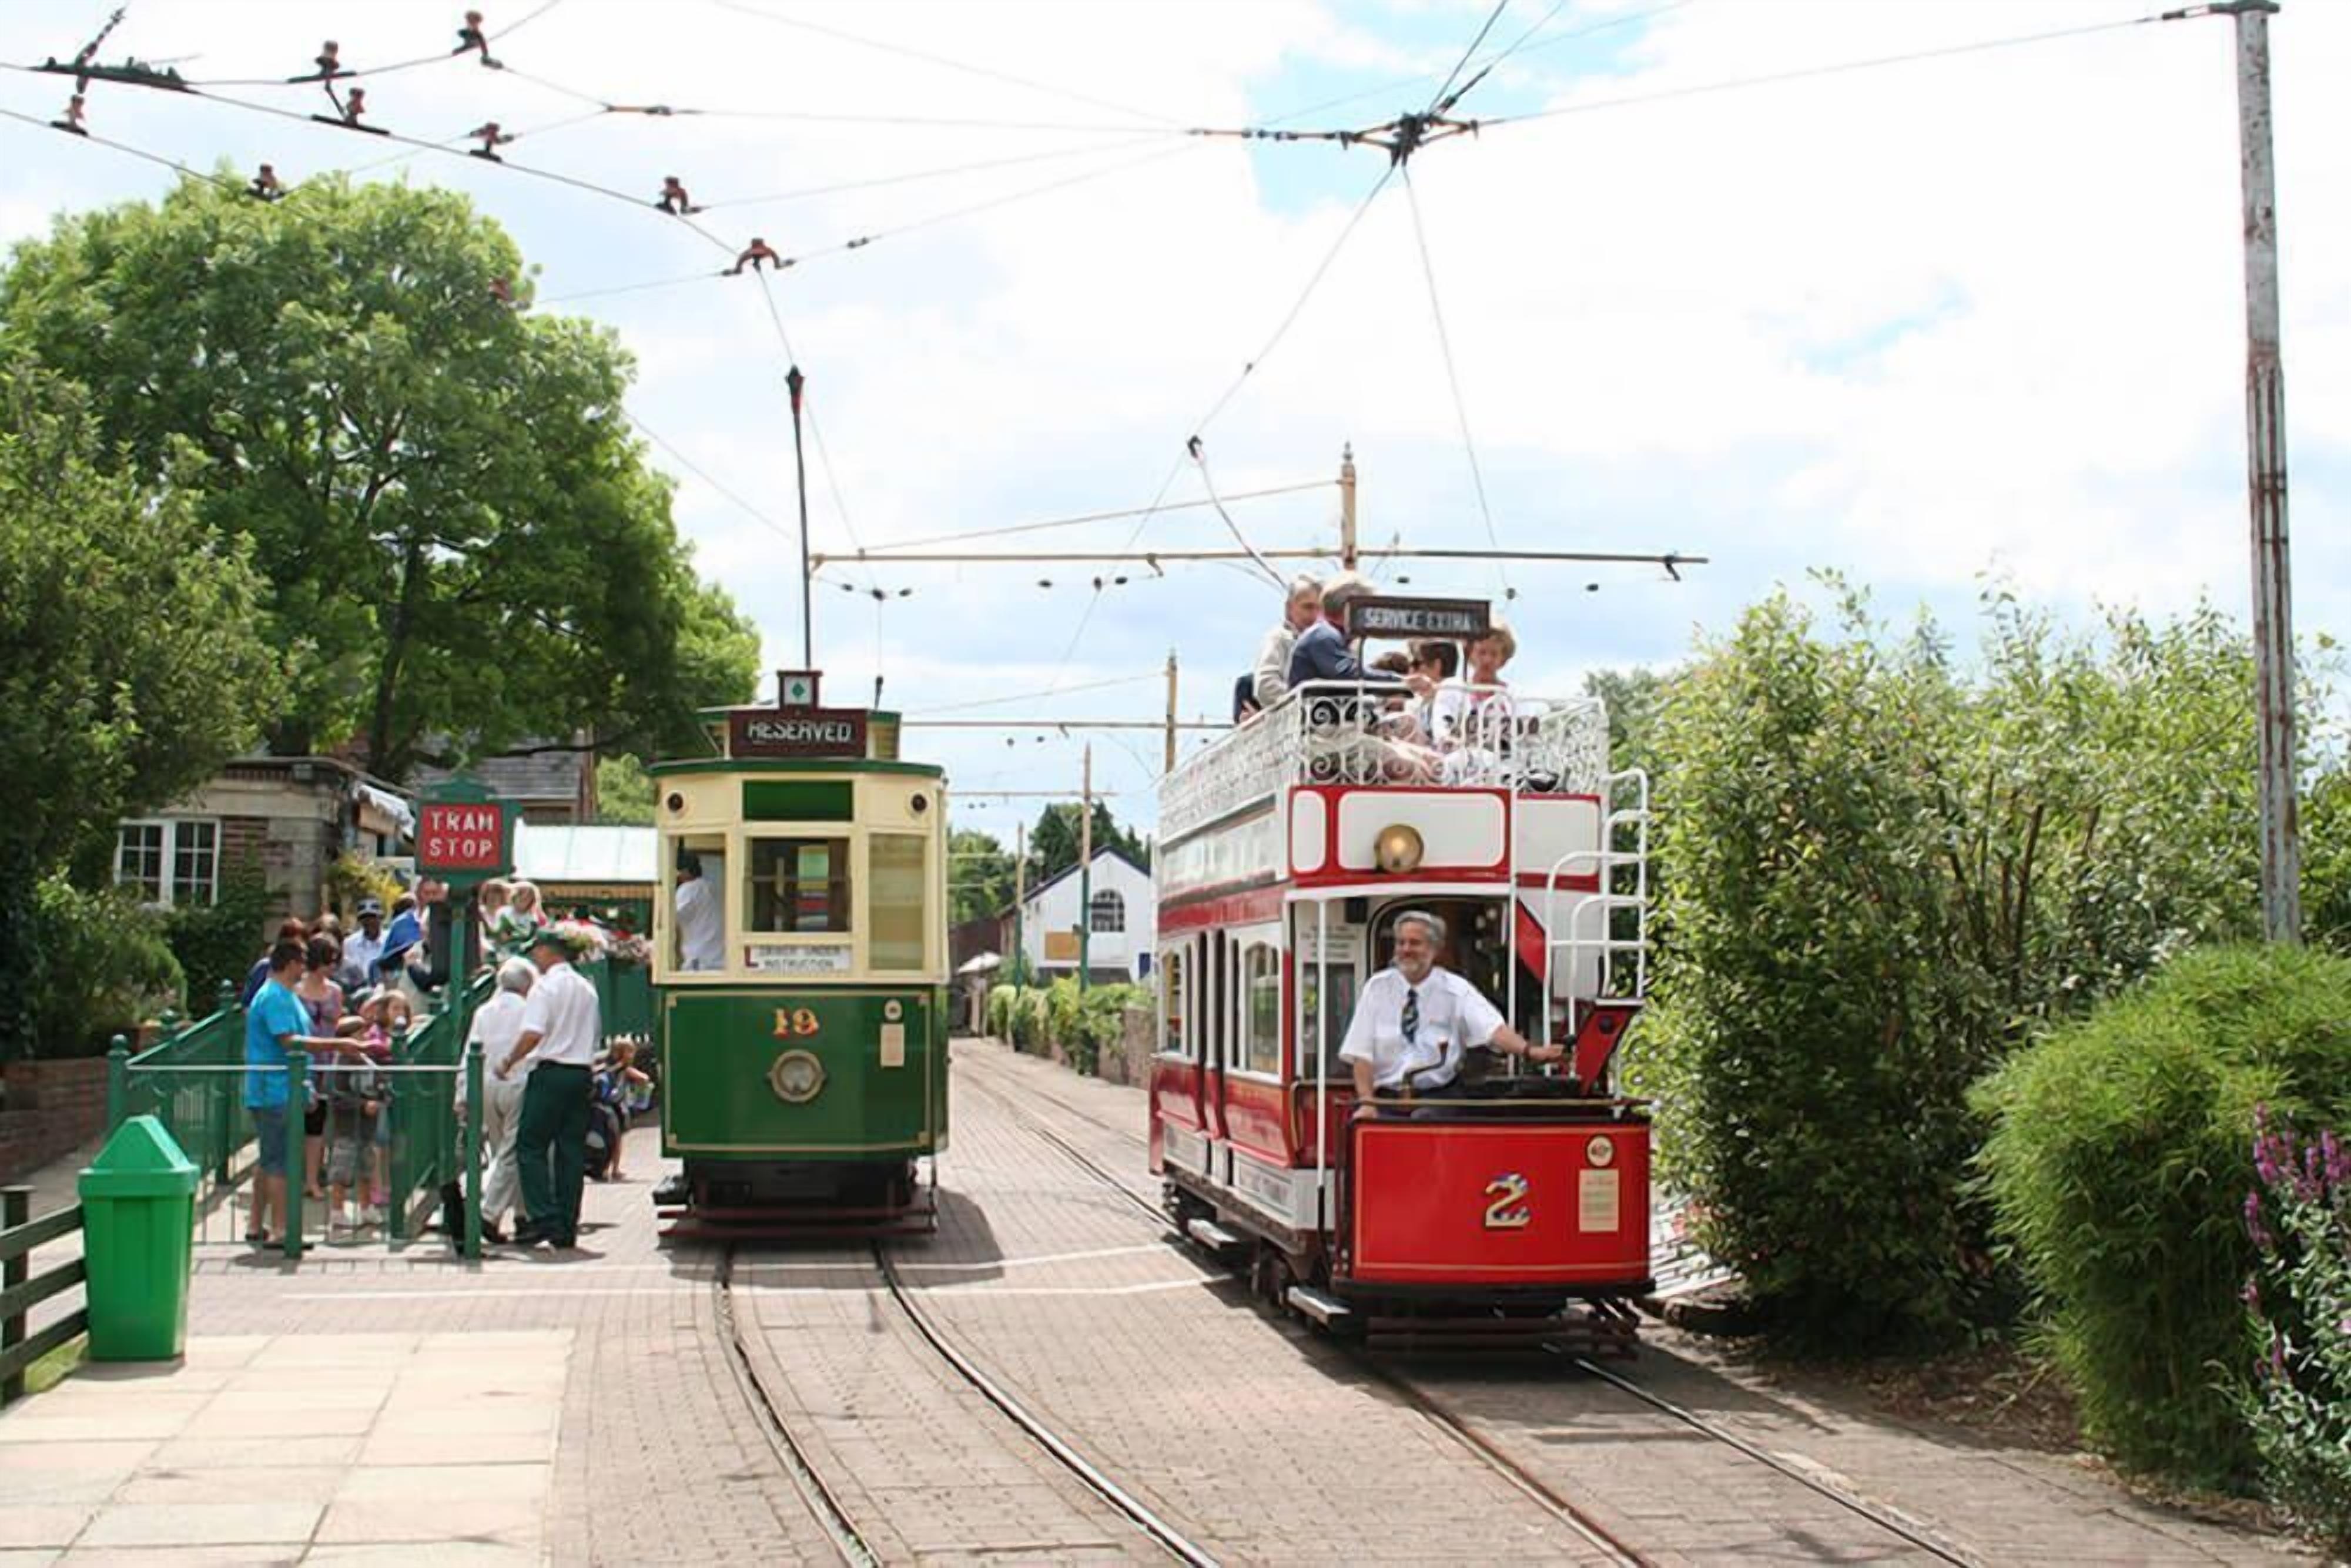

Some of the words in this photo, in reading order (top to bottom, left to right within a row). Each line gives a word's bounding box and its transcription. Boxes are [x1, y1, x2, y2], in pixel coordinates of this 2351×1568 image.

[1364, 607, 1425, 630] SERVICE
[748, 720, 852, 742] RESERVED
[431, 810, 494, 832] TRAM
[429, 837, 493, 857] STOP
[1484, 1172, 1530, 1229] 2
